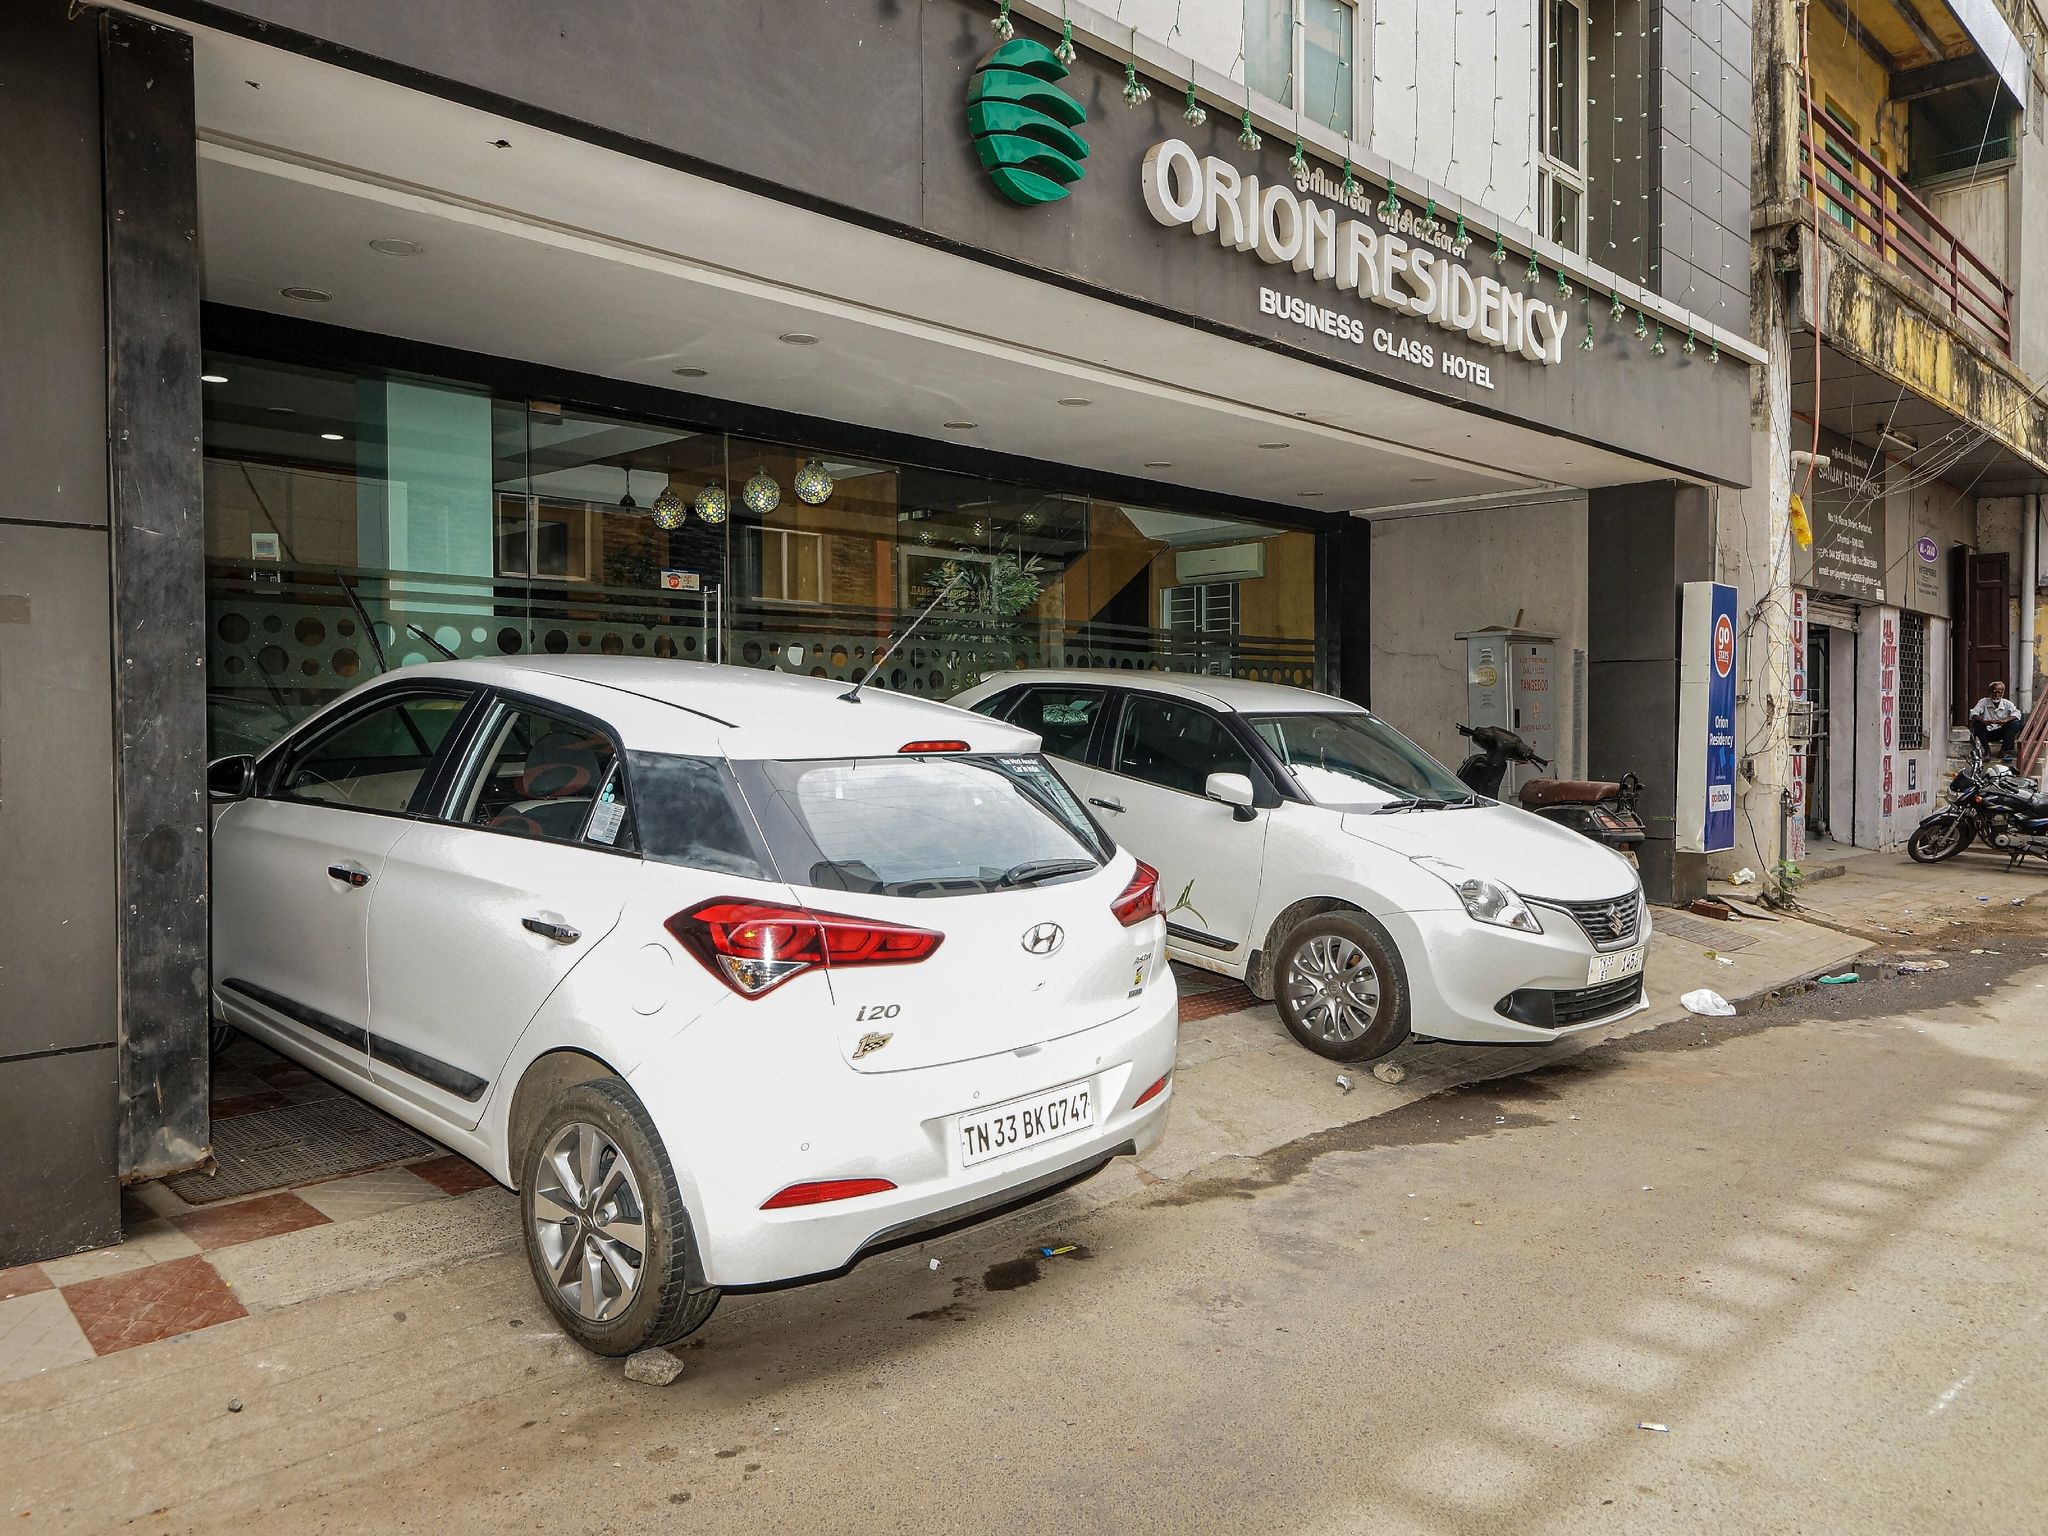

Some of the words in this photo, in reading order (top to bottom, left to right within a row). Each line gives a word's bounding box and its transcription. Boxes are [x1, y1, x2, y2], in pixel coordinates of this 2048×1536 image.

[1142, 139, 1336, 281] ORION
[1336, 219, 1568, 366] RESIDENCY
[1259, 286, 1364, 345] BUSINESS
[1373, 328, 1434, 369] CLASS
[1442, 352, 1495, 390] HOTEL
[1718, 626, 1730, 650] go
[1714, 714, 1729, 729] Orion
[1709, 732, 1734, 748] Residency
[1711, 790, 1730, 806] goibibo
[855, 1004, 901, 1022] i20
[964, 1122, 990, 1156] TN
[994, 1114, 1018, 1148] 33
[1022, 1105, 1046, 1139] BK
[1047, 1091, 1089, 1131] 0747
